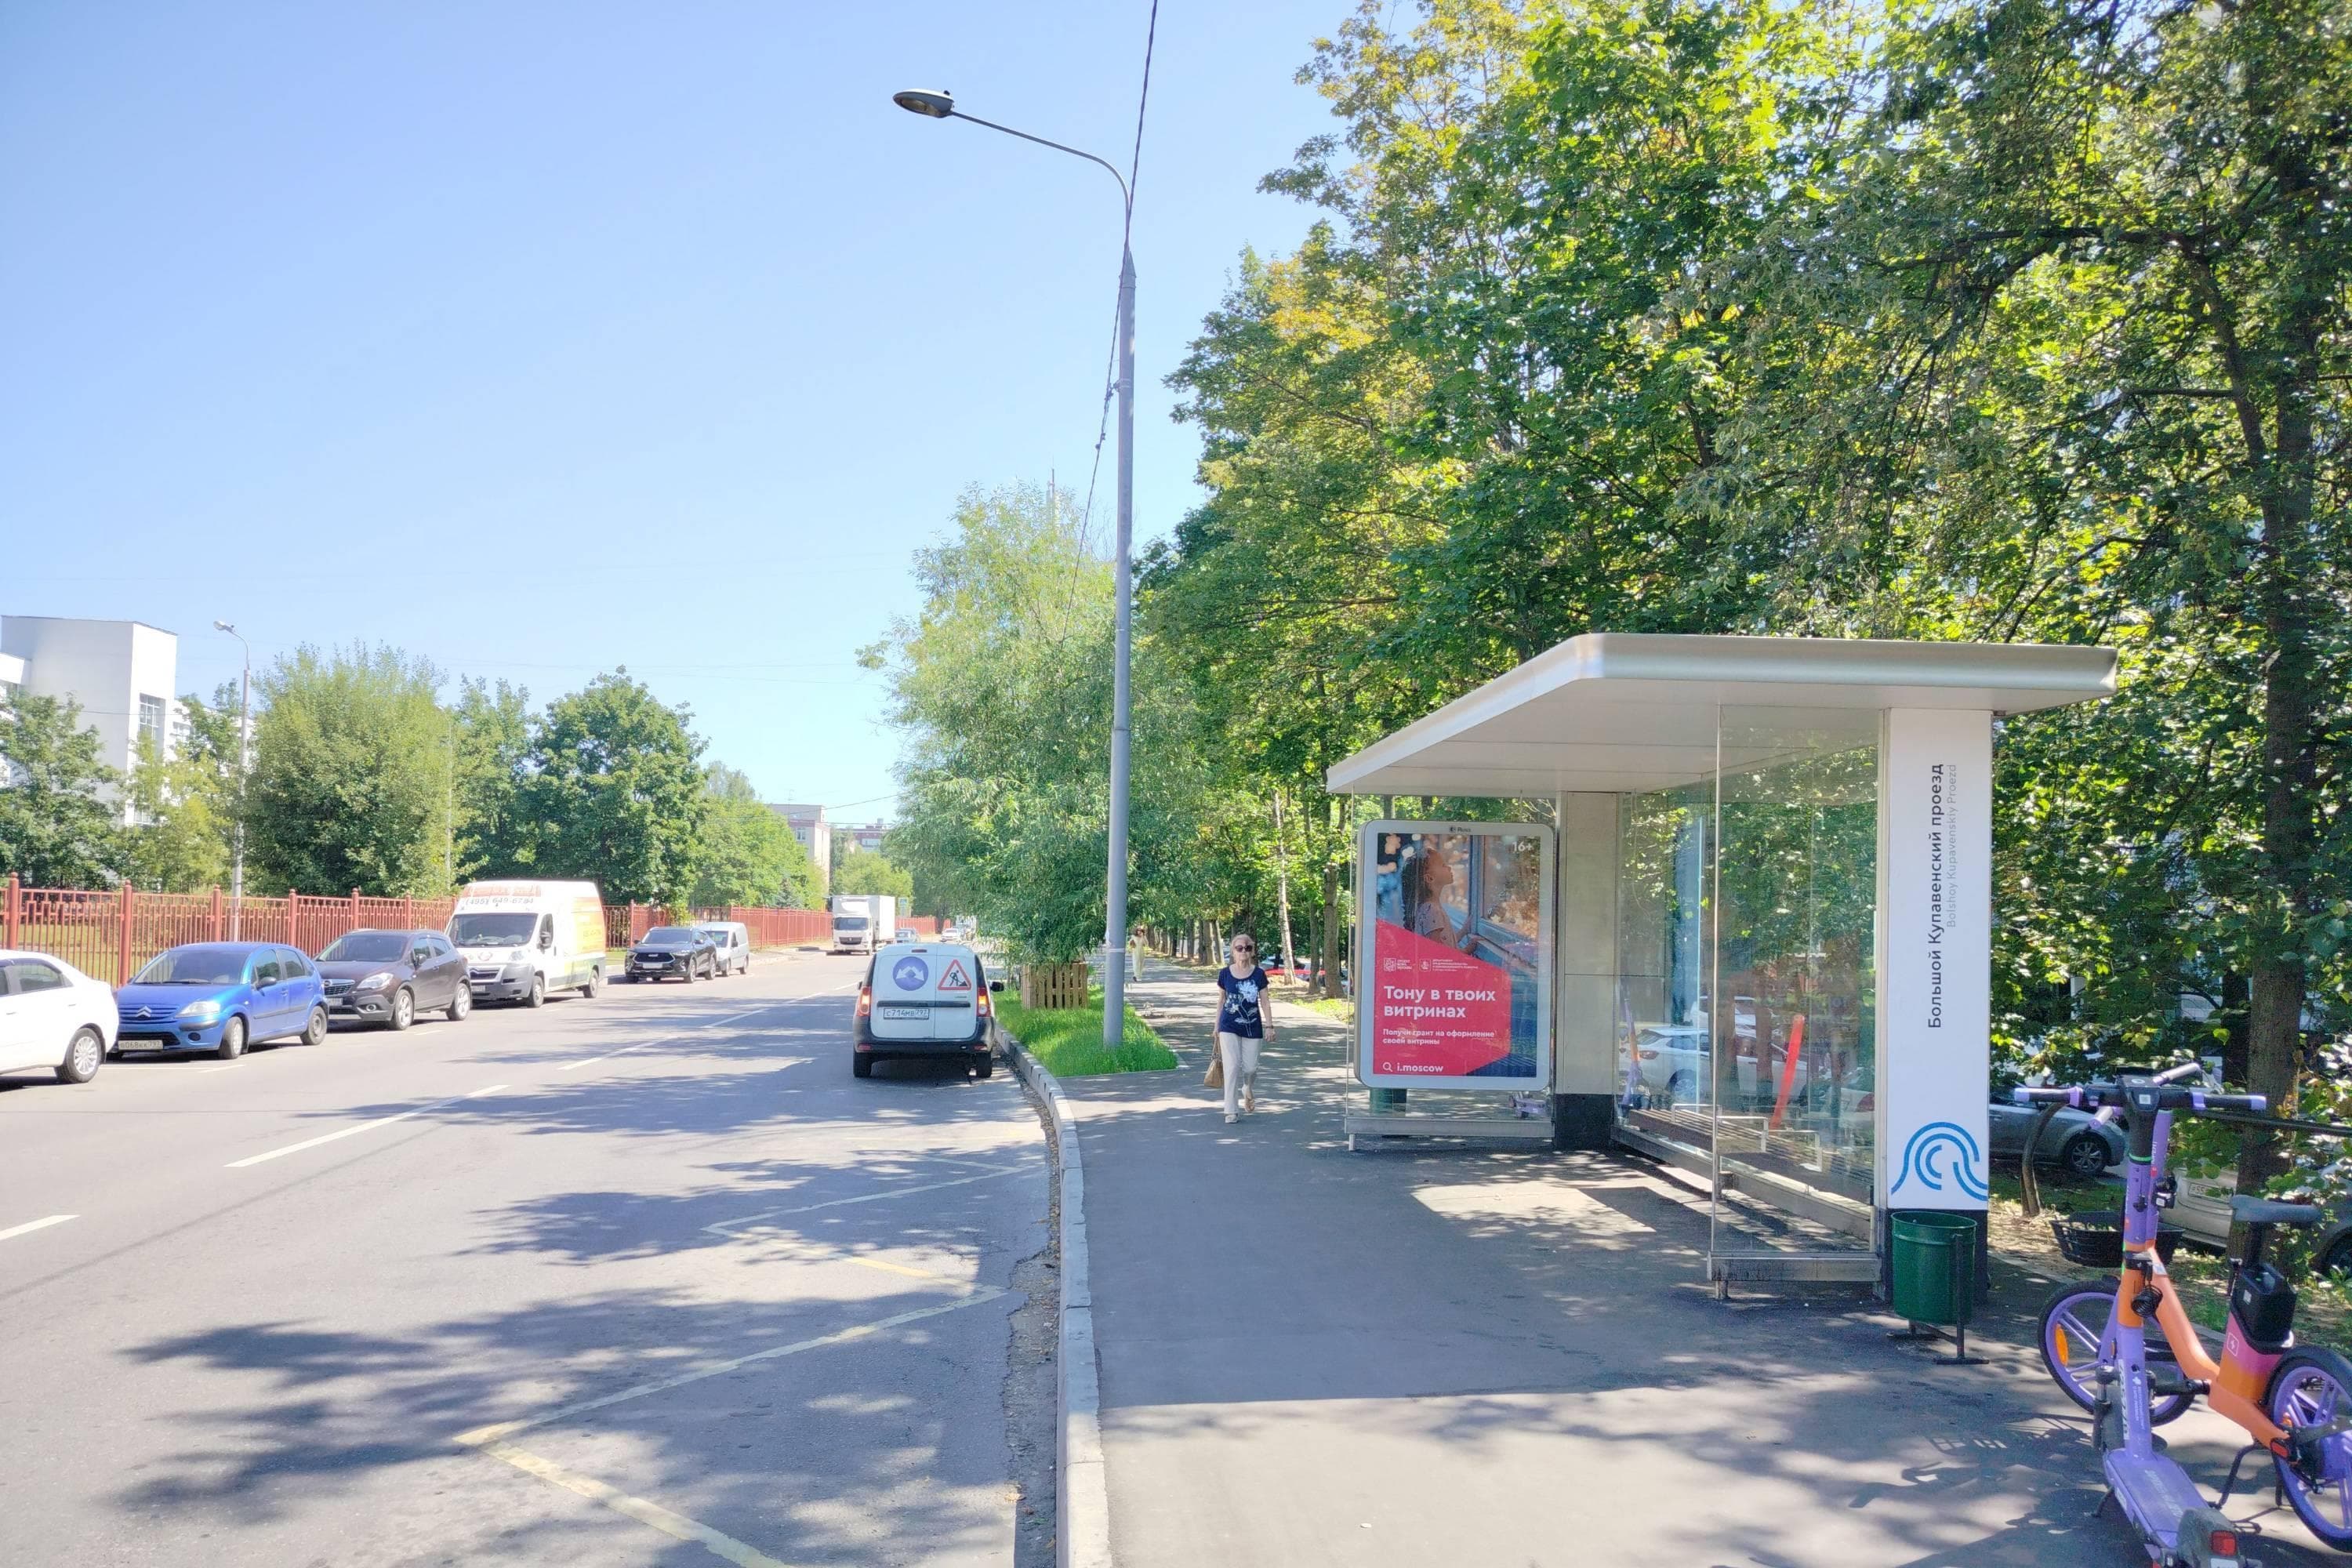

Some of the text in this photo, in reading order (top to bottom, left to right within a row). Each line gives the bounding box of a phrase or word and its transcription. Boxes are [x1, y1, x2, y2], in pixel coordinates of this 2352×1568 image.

[1512, 841, 1534, 852] 16+
[1947, 764, 1958, 927] Bolshoy Kupavenskiy Proezd
[1928, 764, 1944, 1028] Большой Купавенский проезд
[1384, 985, 1496, 1003] Тону в твоих
[1384, 1005, 1466, 1020] витринах
[1383, 1029, 1410, 1037] Получи
[1396, 1062, 1443, 1073] i.moscow
